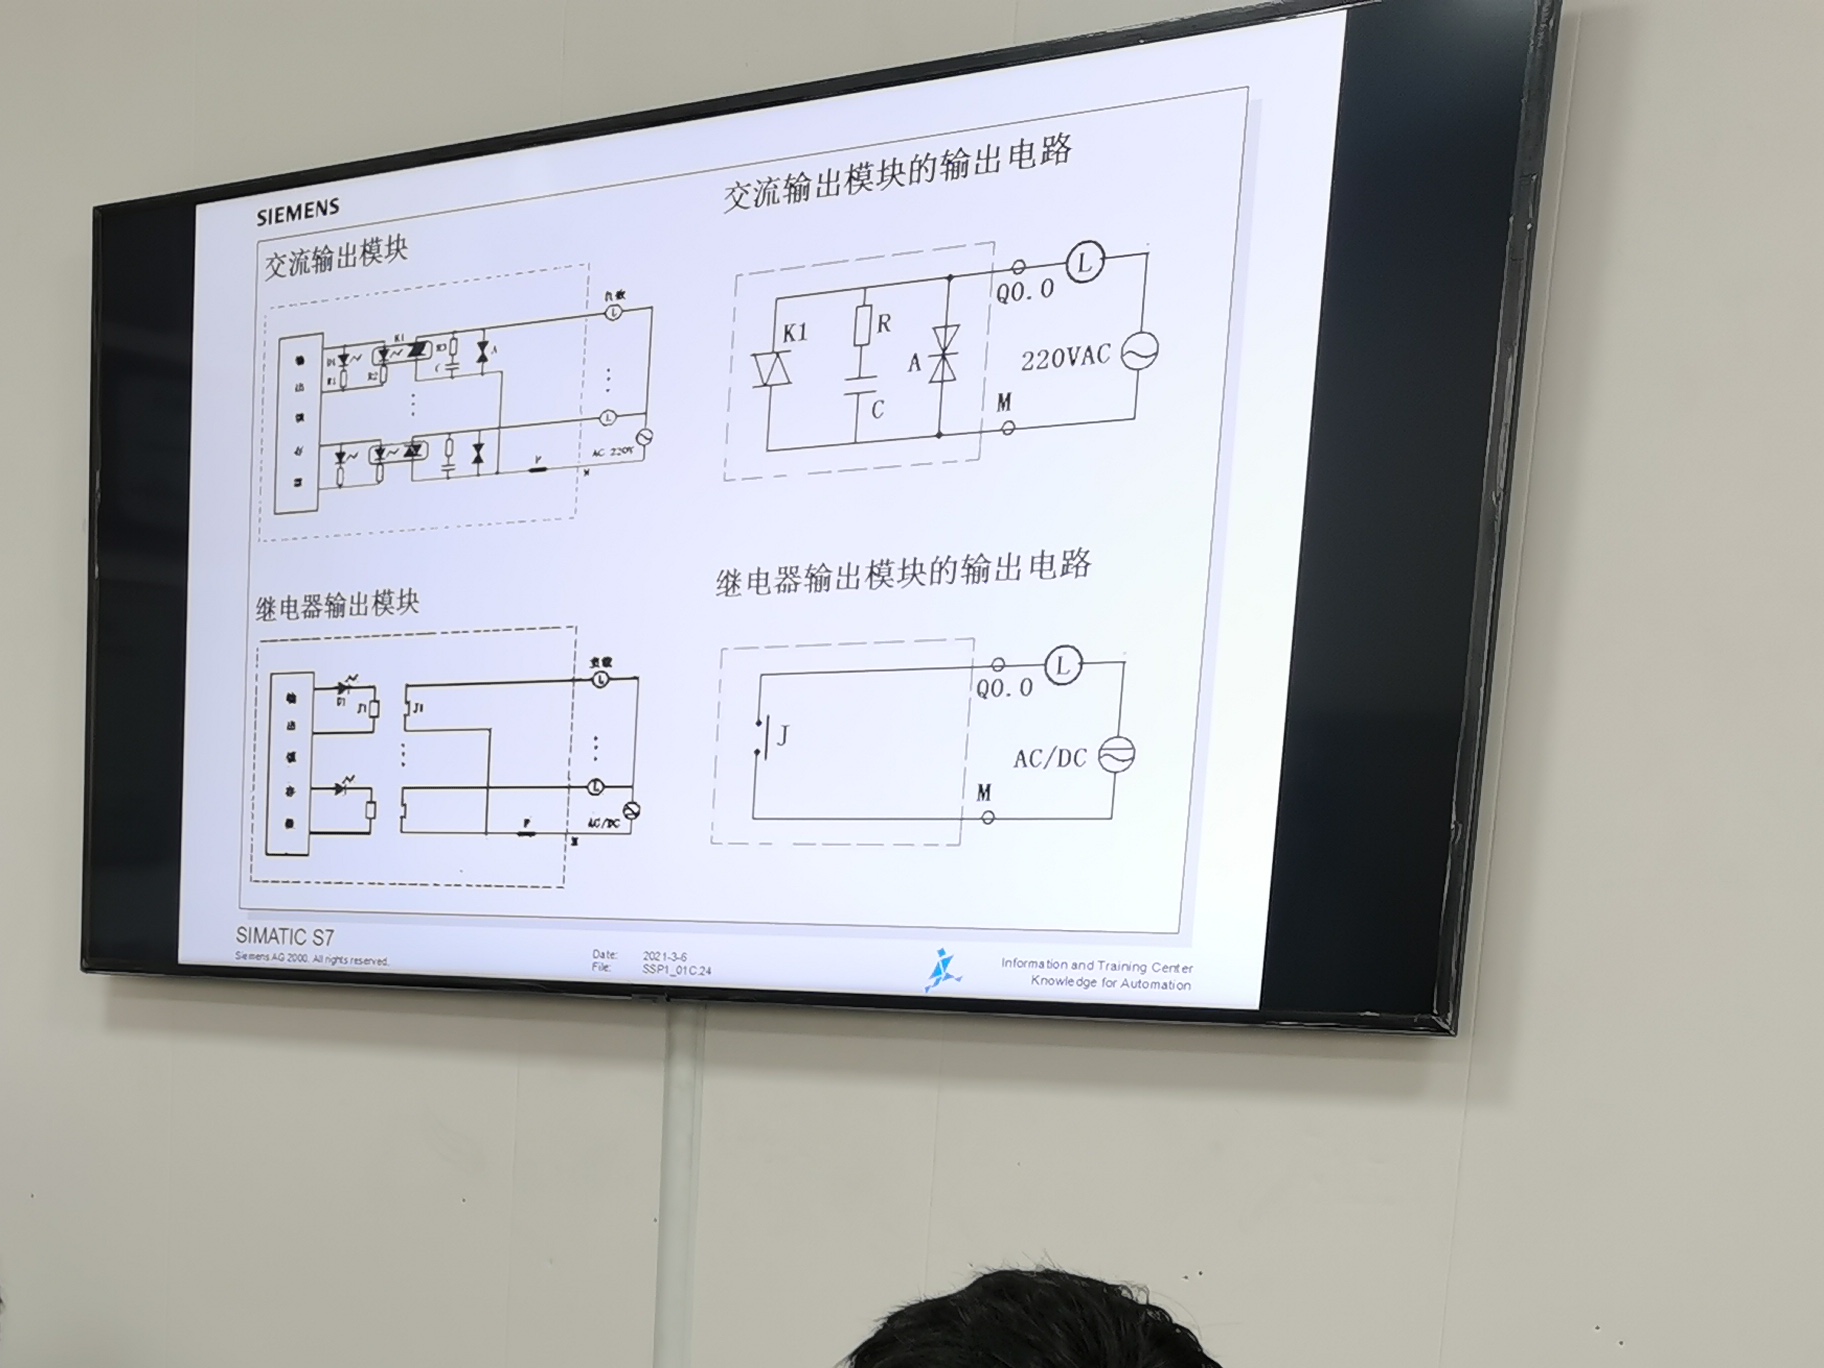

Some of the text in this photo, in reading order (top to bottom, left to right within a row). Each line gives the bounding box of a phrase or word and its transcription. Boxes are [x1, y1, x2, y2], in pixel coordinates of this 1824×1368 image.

[723, 131, 1073, 214] 交流输出模块的输出电路
[256, 198, 340, 226] SIEMENS
[264, 233, 409, 281] 交流输出模块
[1078, 252, 1093, 273] L
[996, 278, 1055, 305] Q0.0
[782, 322, 808, 343] K1
[877, 313, 892, 334] R
[908, 352, 922, 373] A
[1021, 342, 1112, 372] 220VAC
[871, 400, 885, 420] C
[996, 392, 1013, 412] M
[715, 546, 1093, 599] 继电器输出模块的输出电路
[255, 587, 420, 623] 继电器输出模块
[1057, 656, 1071, 676] L
[977, 678, 1034, 701] Q0.0
[776, 724, 790, 747] J
[1013, 745, 1088, 771] AC/DC
[977, 783, 993, 803] M
[236, 926, 335, 946] SIMATIC S7
[235, 951, 269, 963] Siemens
[270, 952, 285, 962] AG
[312, 954, 323, 964] All
[325, 955, 348, 967] rights
[350, 956, 390, 967] reserved.
[593, 949, 687, 962] Date: 2021-3-6
[1001, 957, 1194, 975] Information and Training Center
[592, 962, 712, 977] File: SSP1_01C.24
[1031, 975, 1192, 991] Knowledge for Automation
